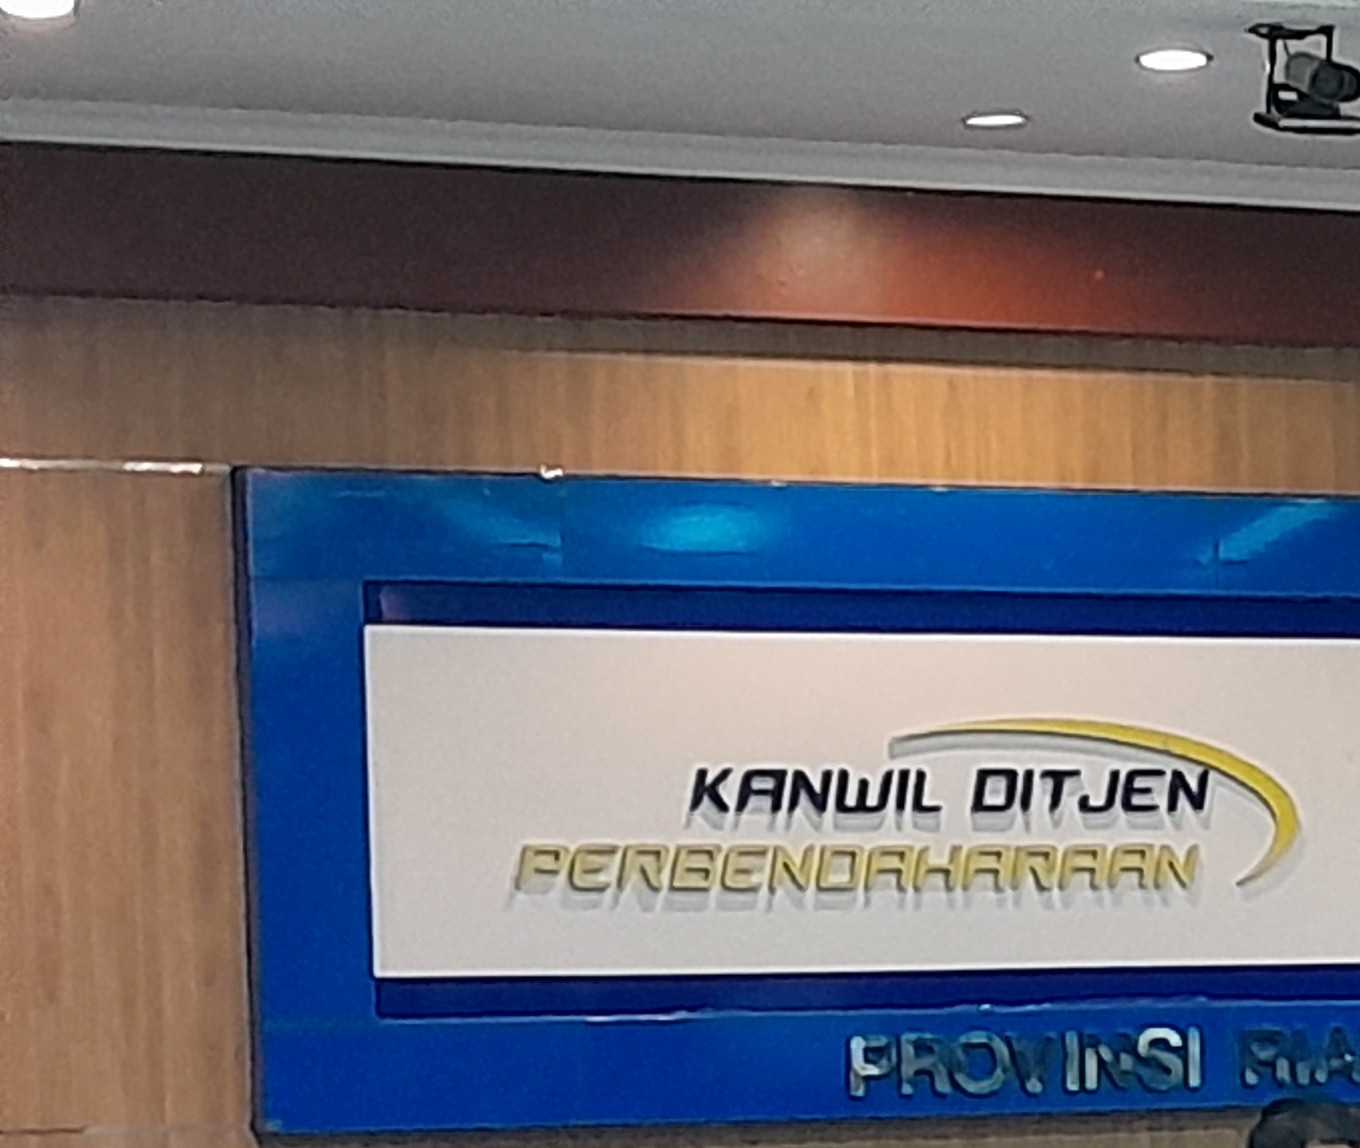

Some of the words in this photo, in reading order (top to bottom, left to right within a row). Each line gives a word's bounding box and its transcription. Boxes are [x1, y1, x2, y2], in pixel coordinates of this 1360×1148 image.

[688, 767, 943, 814] KANWIL
[970, 767, 1211, 814] DITJEN
[513, 843, 1199, 893] PERBENDAHARAAN
[849, 1026, 1202, 1097] PROVINSI
